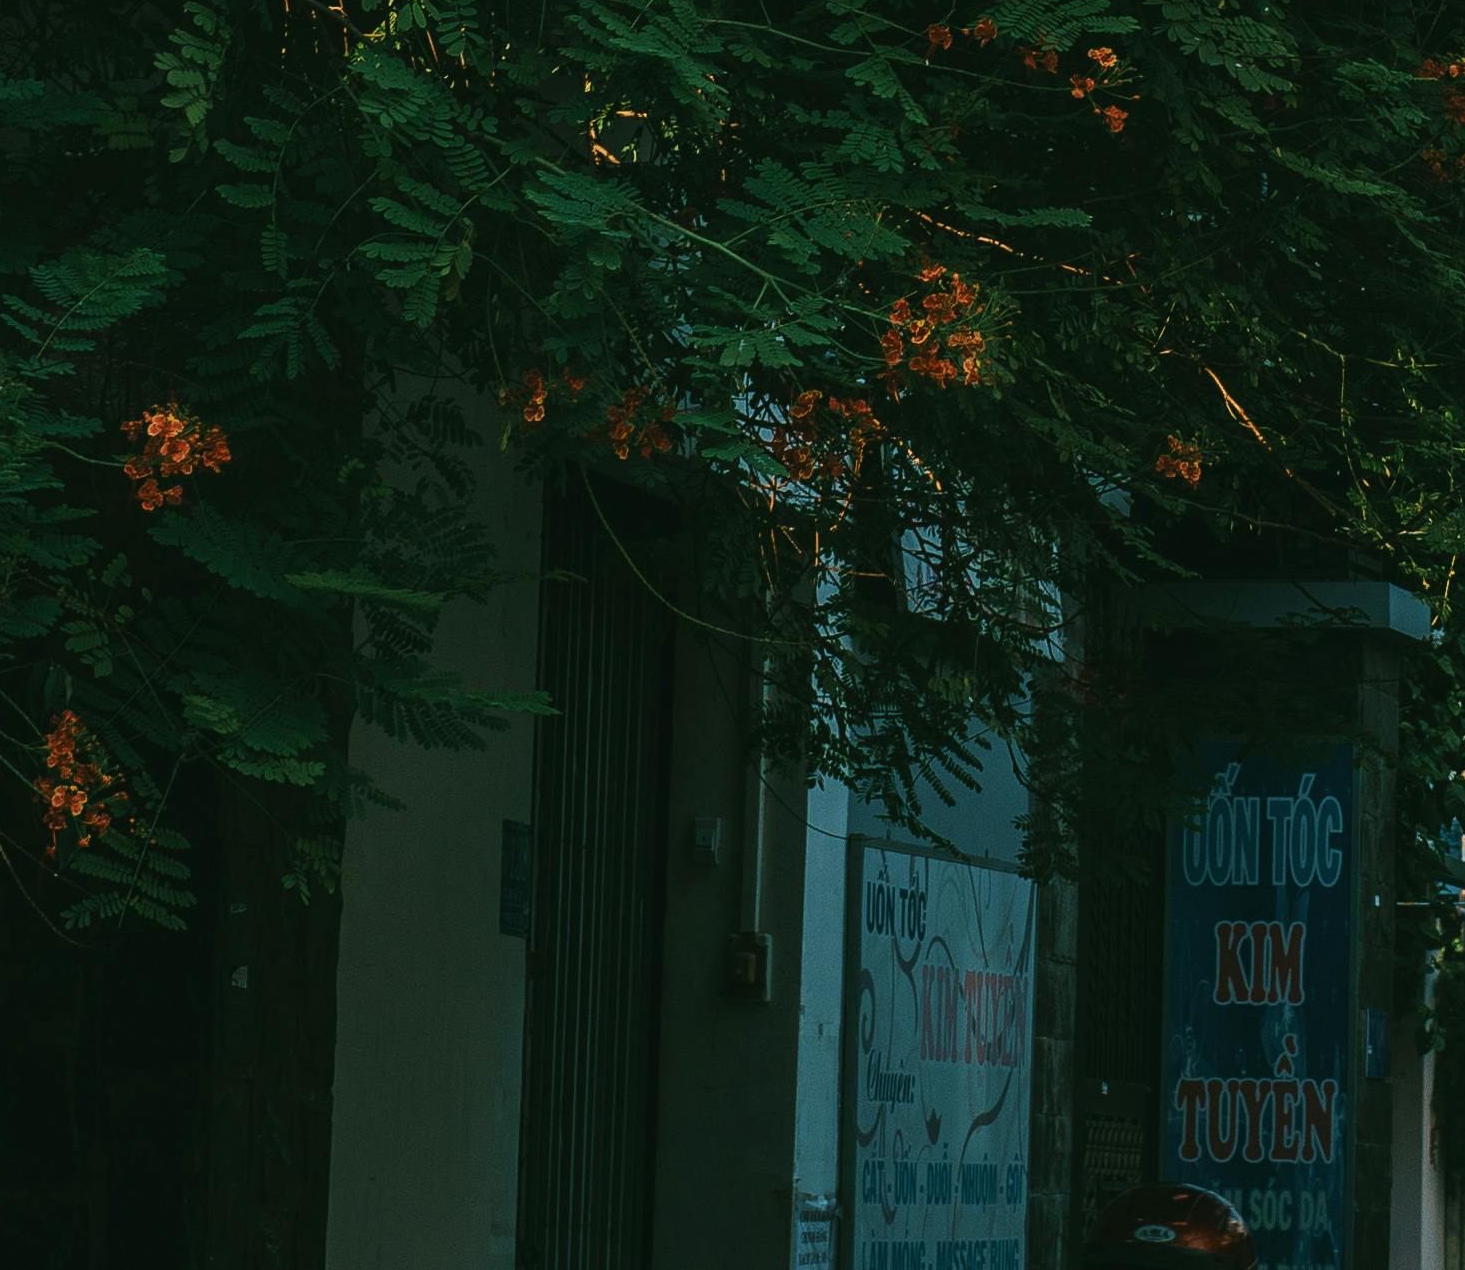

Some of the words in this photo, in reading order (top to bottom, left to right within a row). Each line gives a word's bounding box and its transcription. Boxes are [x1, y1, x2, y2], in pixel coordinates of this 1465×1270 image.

[1265, 772, 1345, 887] TÓC
[866, 864, 896, 936] UỐN
[1213, 920, 1307, 1007] KIM
[920, 963, 960, 1063] KIM
[1174, 1032, 1339, 1165] TUYỀN
[894, 1145, 918, 1205] UỐN
[1248, 1176, 1293, 1232] SÓC
